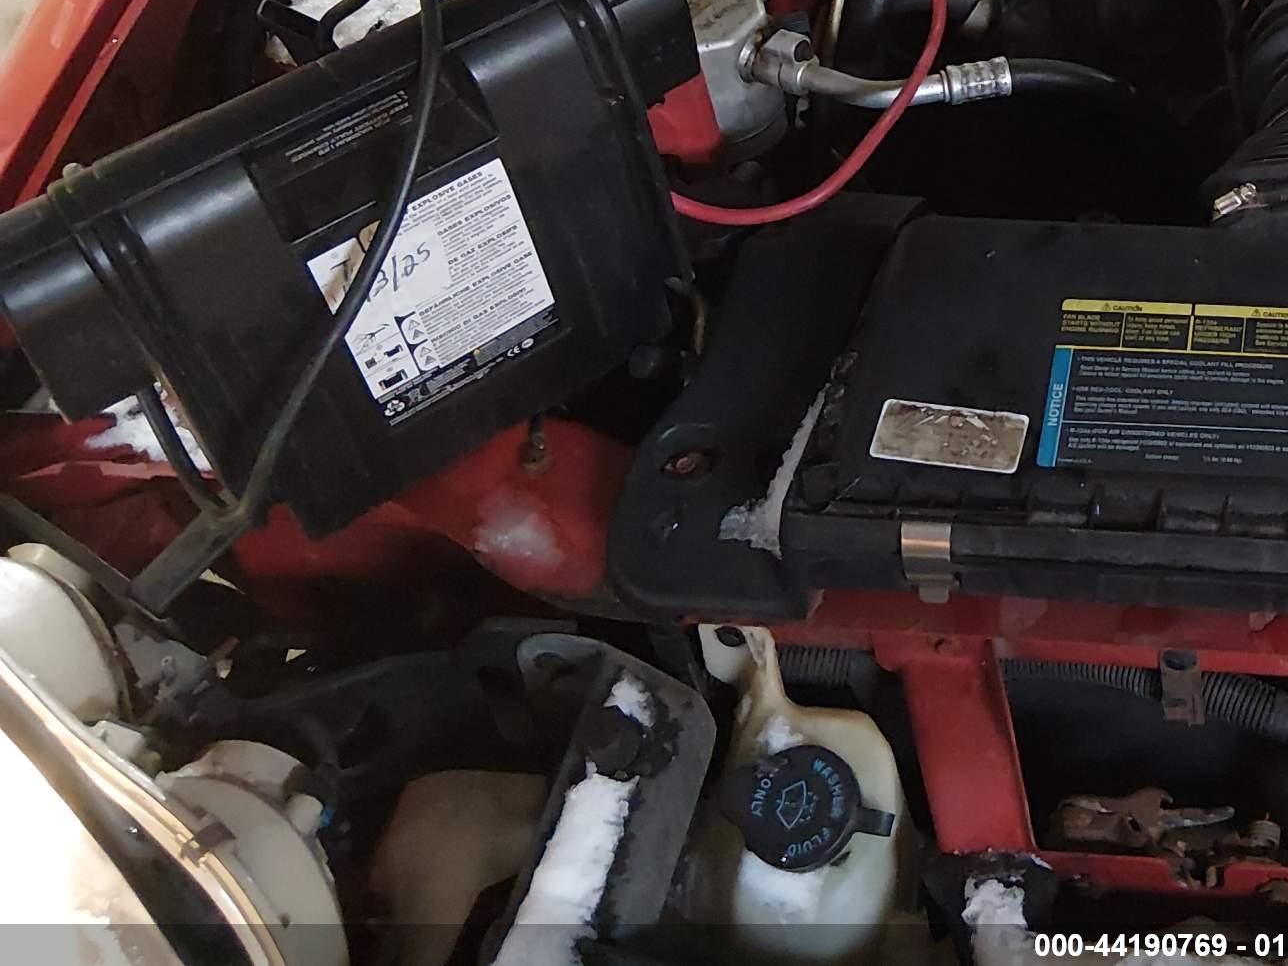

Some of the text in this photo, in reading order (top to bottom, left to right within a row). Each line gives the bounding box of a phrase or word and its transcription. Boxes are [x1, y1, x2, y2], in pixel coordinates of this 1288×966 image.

[411, 184, 455, 212] EXPLOSIVE
[456, 170, 483, 188] GASES
[1112, 303, 1143, 312] CAUTION
[1047, 383, 1064, 427] NOTICE
[751, 778, 772, 817] ONLY
[813, 758, 844, 818] WASHER
[787, 827, 833, 856] FLUID
